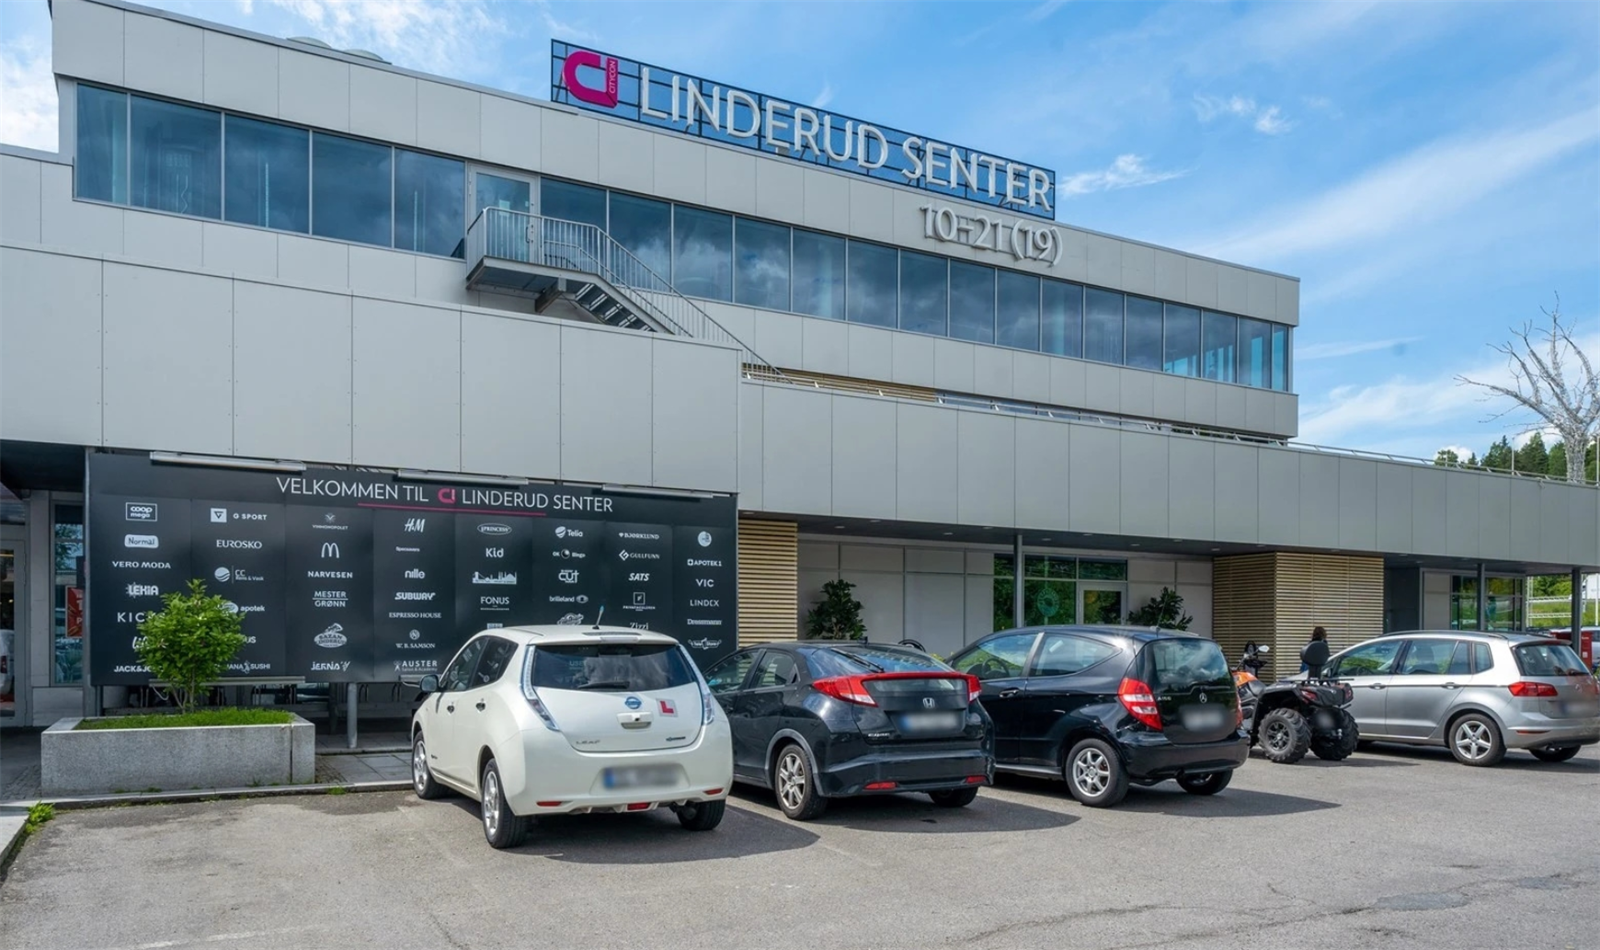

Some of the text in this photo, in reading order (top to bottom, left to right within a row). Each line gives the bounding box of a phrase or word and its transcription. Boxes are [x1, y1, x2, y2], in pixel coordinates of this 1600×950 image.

[608, 60, 617, 95] CITYCON
[641, 66, 1053, 212] LINDERUD SENTER
[920, 203, 1064, 267] 10-21 (19)
[276, 476, 429, 502] VELKOMMEN TIL
[462, 488, 613, 513] LINDERUD SENTER
[130, 506, 153, 514] coop
[241, 513, 268, 521] SPORT
[404, 518, 426, 533] H&M
[567, 528, 584, 538] Telia
[624, 532, 660, 540] BJØRKLUND
[127, 537, 156, 547] Normal
[216, 539, 263, 550] EUROSKO
[485, 547, 505, 558] Kid
[630, 552, 661, 560] GULLFUNN
[112, 560, 172, 569] VERO MODA
[694, 558, 717, 567] APOTEK
[235, 569, 246, 577] CC
[307, 570, 353, 579] NARVESEN
[404, 568, 426, 579] nille
[628, 572, 650, 582] SATS
[695, 578, 715, 588] VIC
[314, 590, 347, 598] MESTER
[394, 591, 436, 601] SUBWAY
[314, 599, 347, 608] GRØNN
[480, 596, 510, 605] FONUS
[549, 595, 575, 603] brilleland
[689, 599, 720, 607] LINDEX
[240, 604, 266, 613] apotek
[630, 622, 649, 630] Zizzi
[250, 663, 271, 671] SUSHI
[661, 700, 674, 714] L
